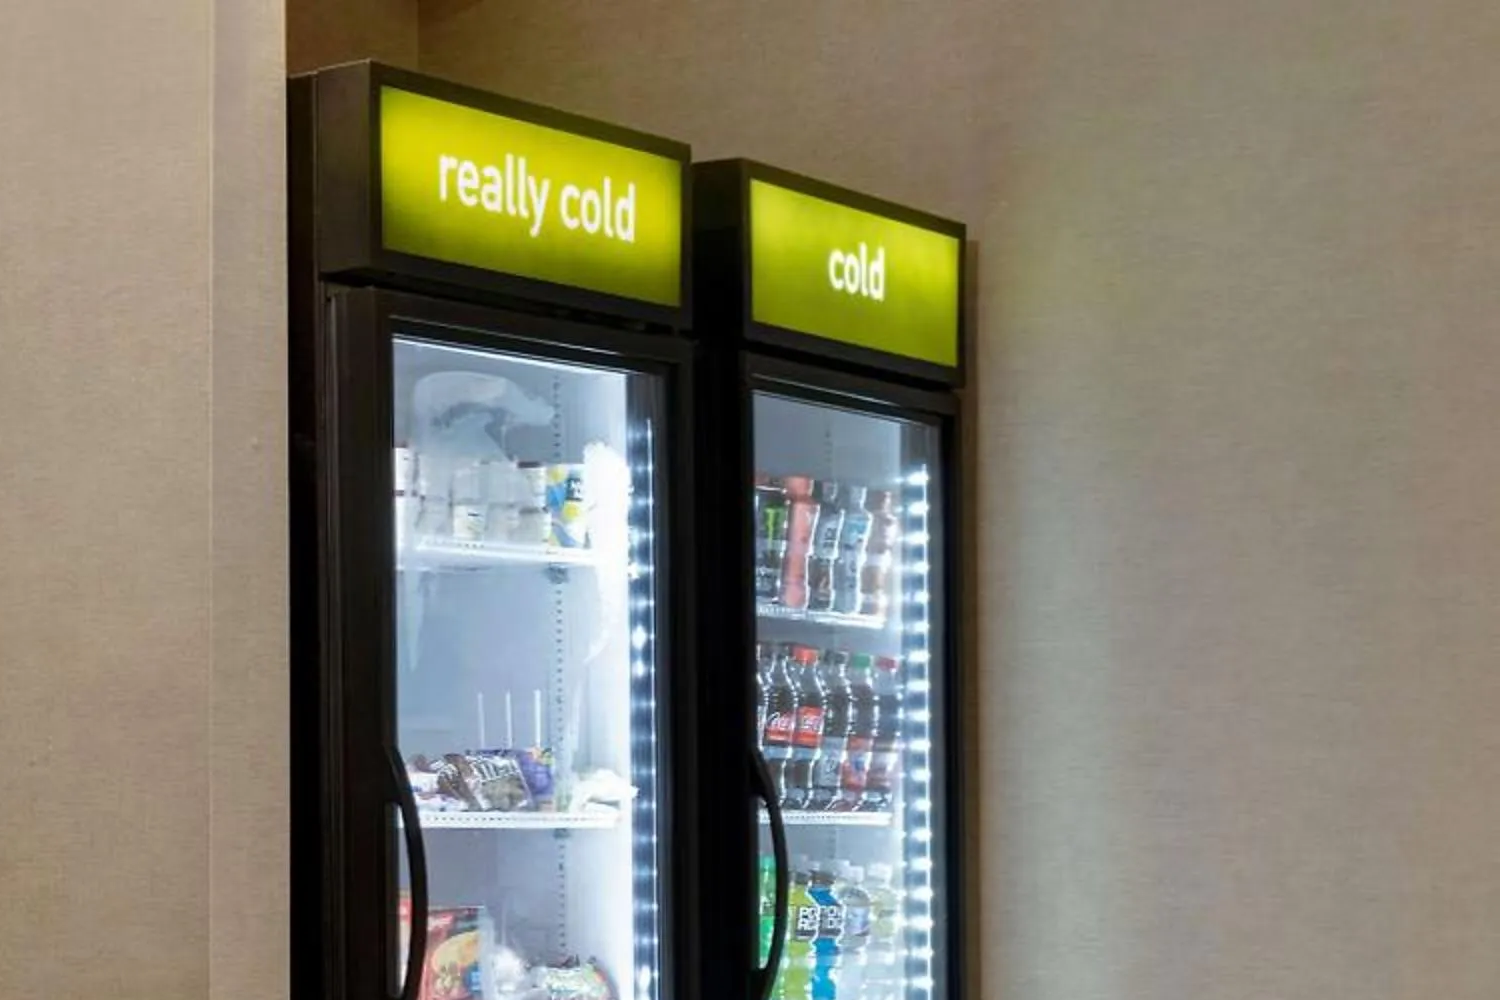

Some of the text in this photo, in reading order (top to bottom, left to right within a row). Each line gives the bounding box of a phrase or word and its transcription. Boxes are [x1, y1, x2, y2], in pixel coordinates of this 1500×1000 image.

[438, 153, 636, 243] really cold
[828, 242, 885, 301] cold
